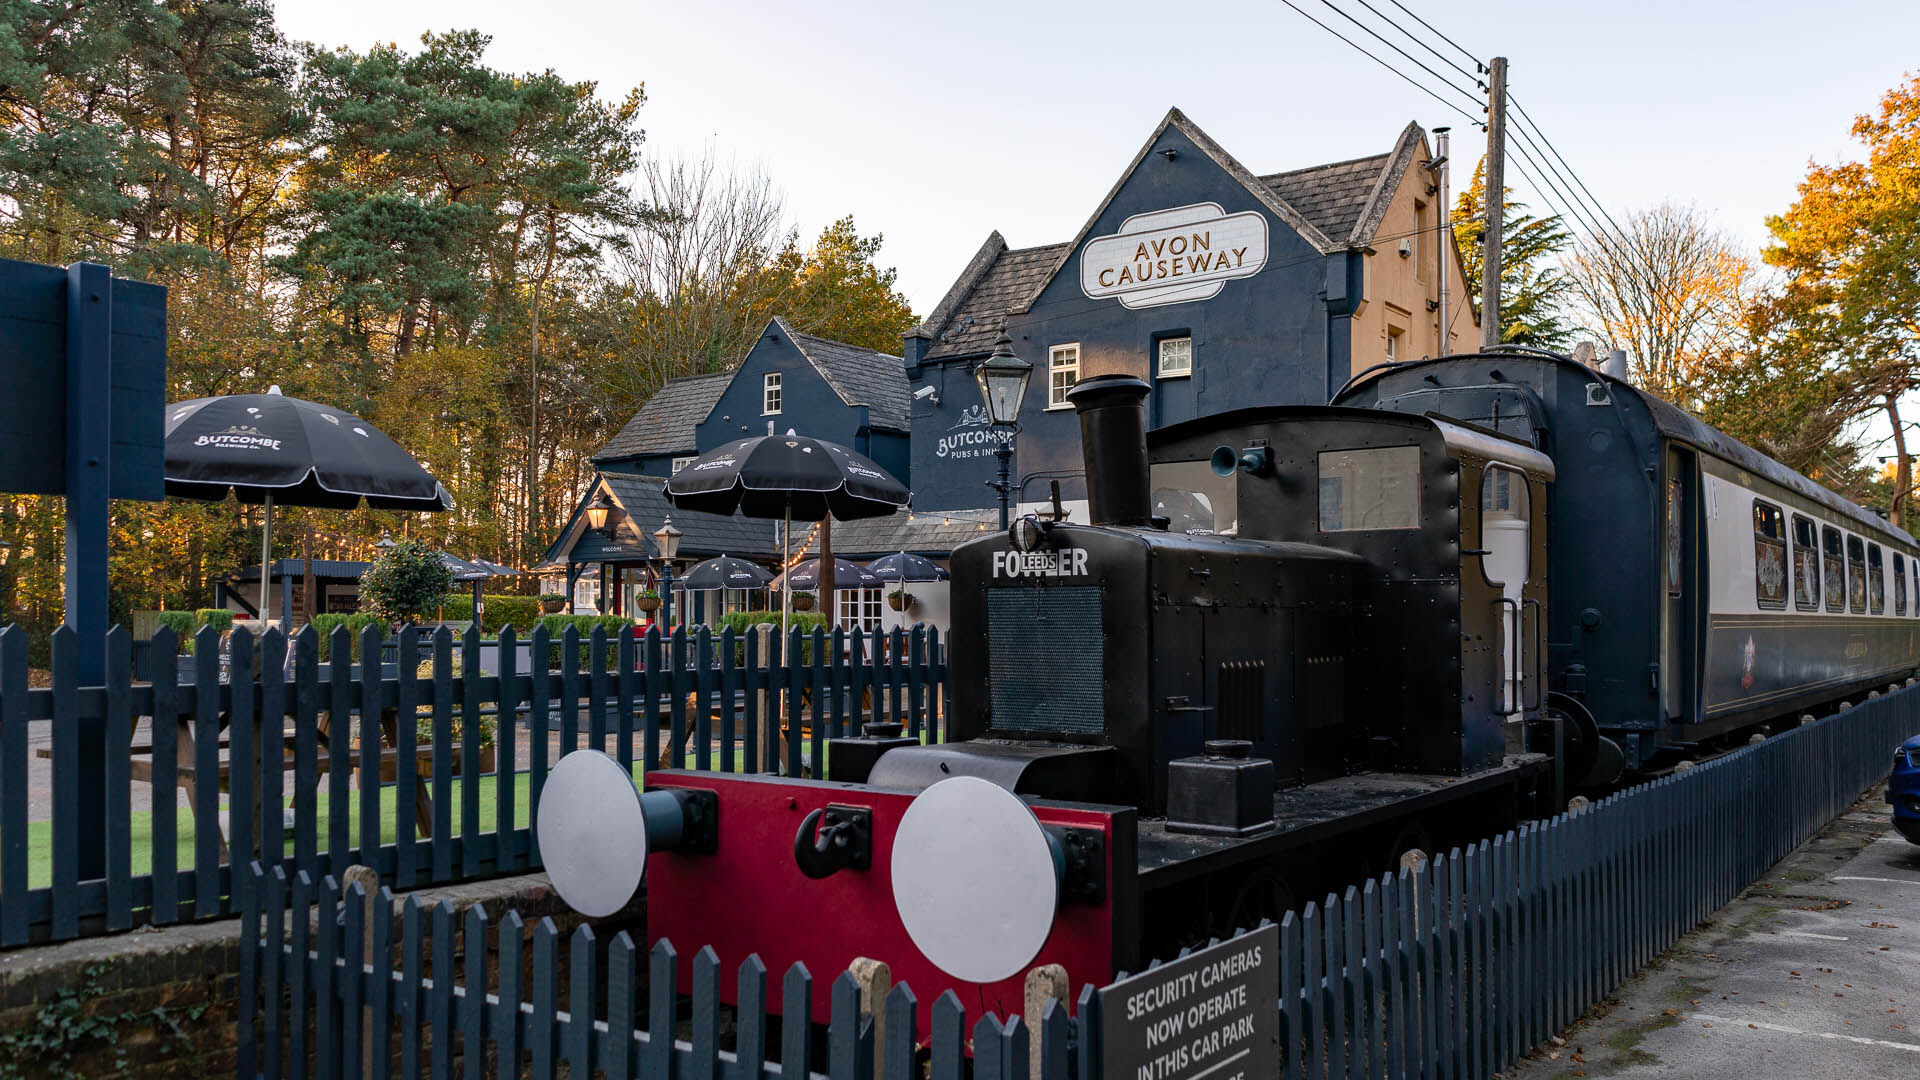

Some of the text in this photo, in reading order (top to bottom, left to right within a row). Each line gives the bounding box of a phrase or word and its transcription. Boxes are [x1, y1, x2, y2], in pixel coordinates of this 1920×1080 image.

[1134, 231, 1210, 262] AVON
[1098, 246, 1248, 287] CAUSEWAY
[194, 435, 281, 450] BUTCOMBE
[951, 450, 972, 459] PUBS
[974, 449, 980, 457] &
[1022, 555, 1056, 570] LEEDS
[1127, 946, 1262, 1021] SECURITY CAMERAS
[1146, 984, 1247, 1049] NOW OPERATE
[1155, 1045, 1189, 1080] THIS
[1192, 1029, 1220, 1062] CAR
[1223, 1013, 1255, 1047] PARK
